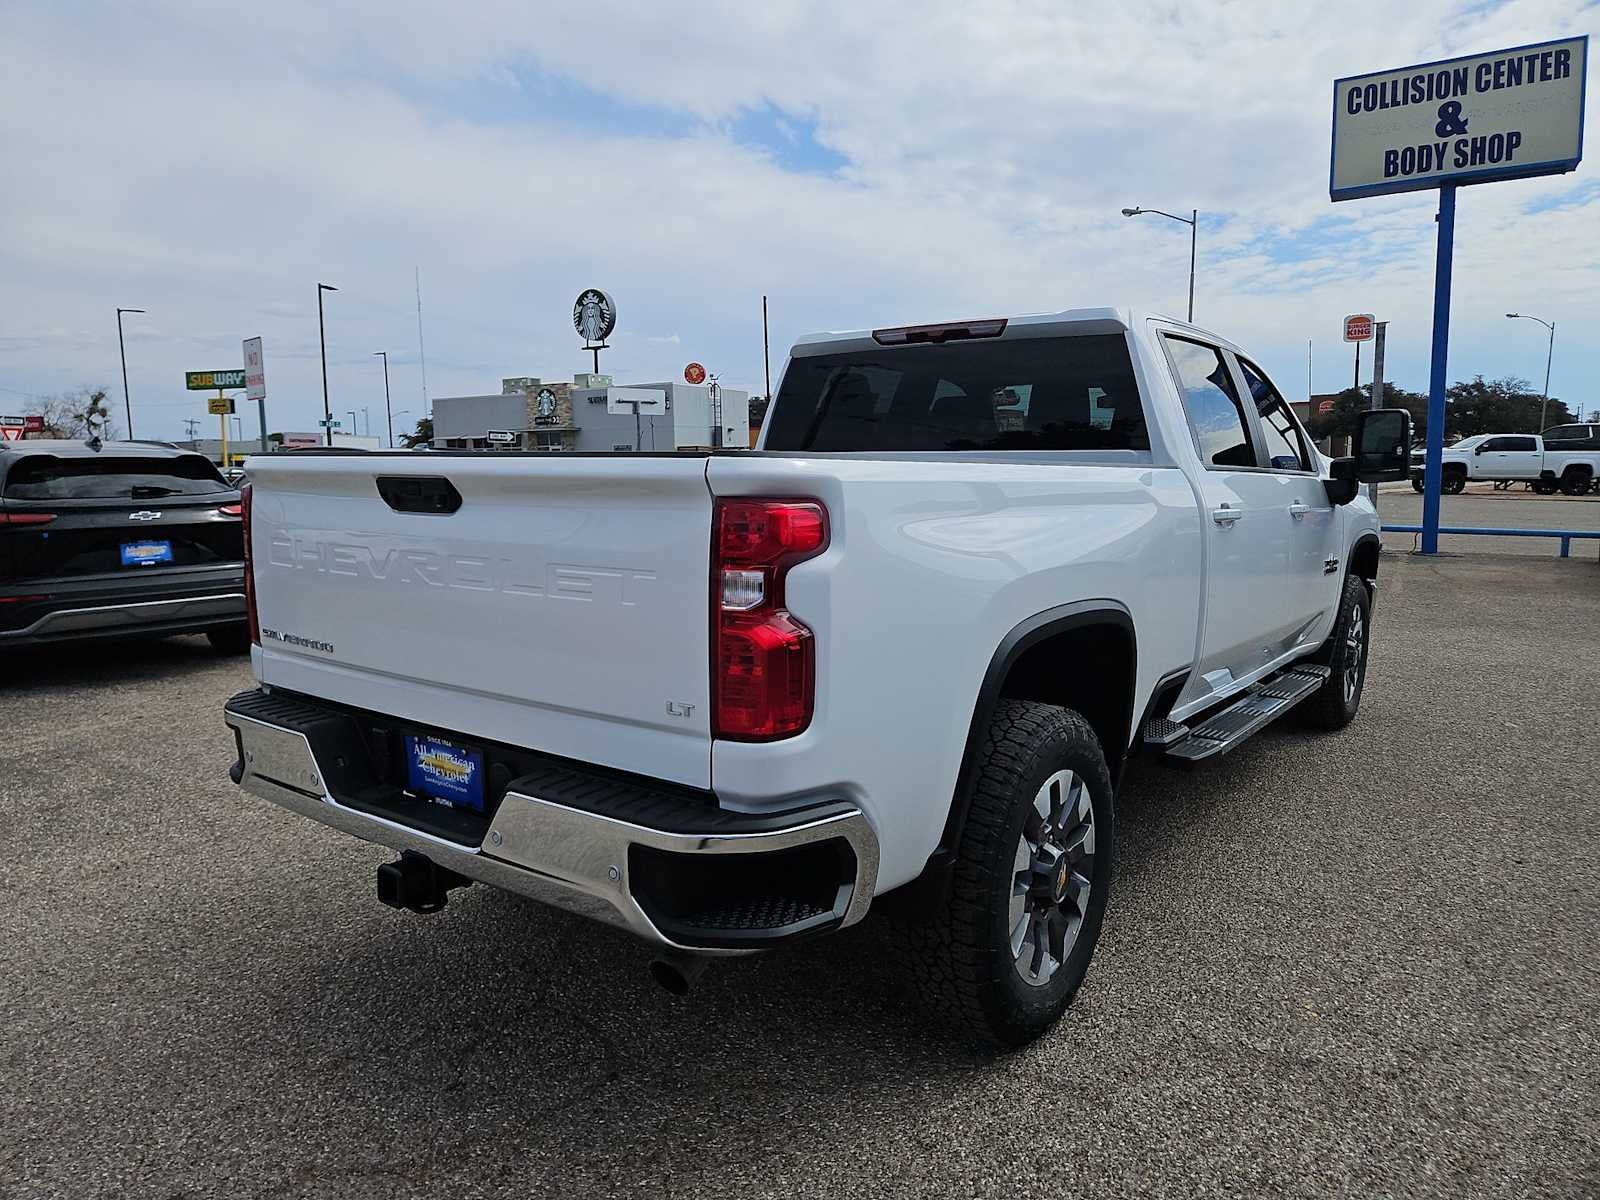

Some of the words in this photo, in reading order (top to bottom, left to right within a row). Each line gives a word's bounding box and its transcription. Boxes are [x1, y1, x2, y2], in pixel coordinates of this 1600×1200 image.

[1347, 67, 1469, 115] COLLISION
[1475, 49, 1571, 93] CENTER
[1434, 100, 1469, 139] &
[1383, 142, 1449, 178] BODY
[1453, 131, 1522, 170] SHOP
[1347, 328, 1371, 336] KING
[190, 372, 244, 386] SUBWAY
[268, 527, 657, 607] CHEVROLET
[262, 628, 334, 653] SILVERADO
[665, 701, 696, 718] LT
[413, 743, 427, 757] All
[430, 748, 475, 771] American
[422, 760, 469, 784] Chevrolet
